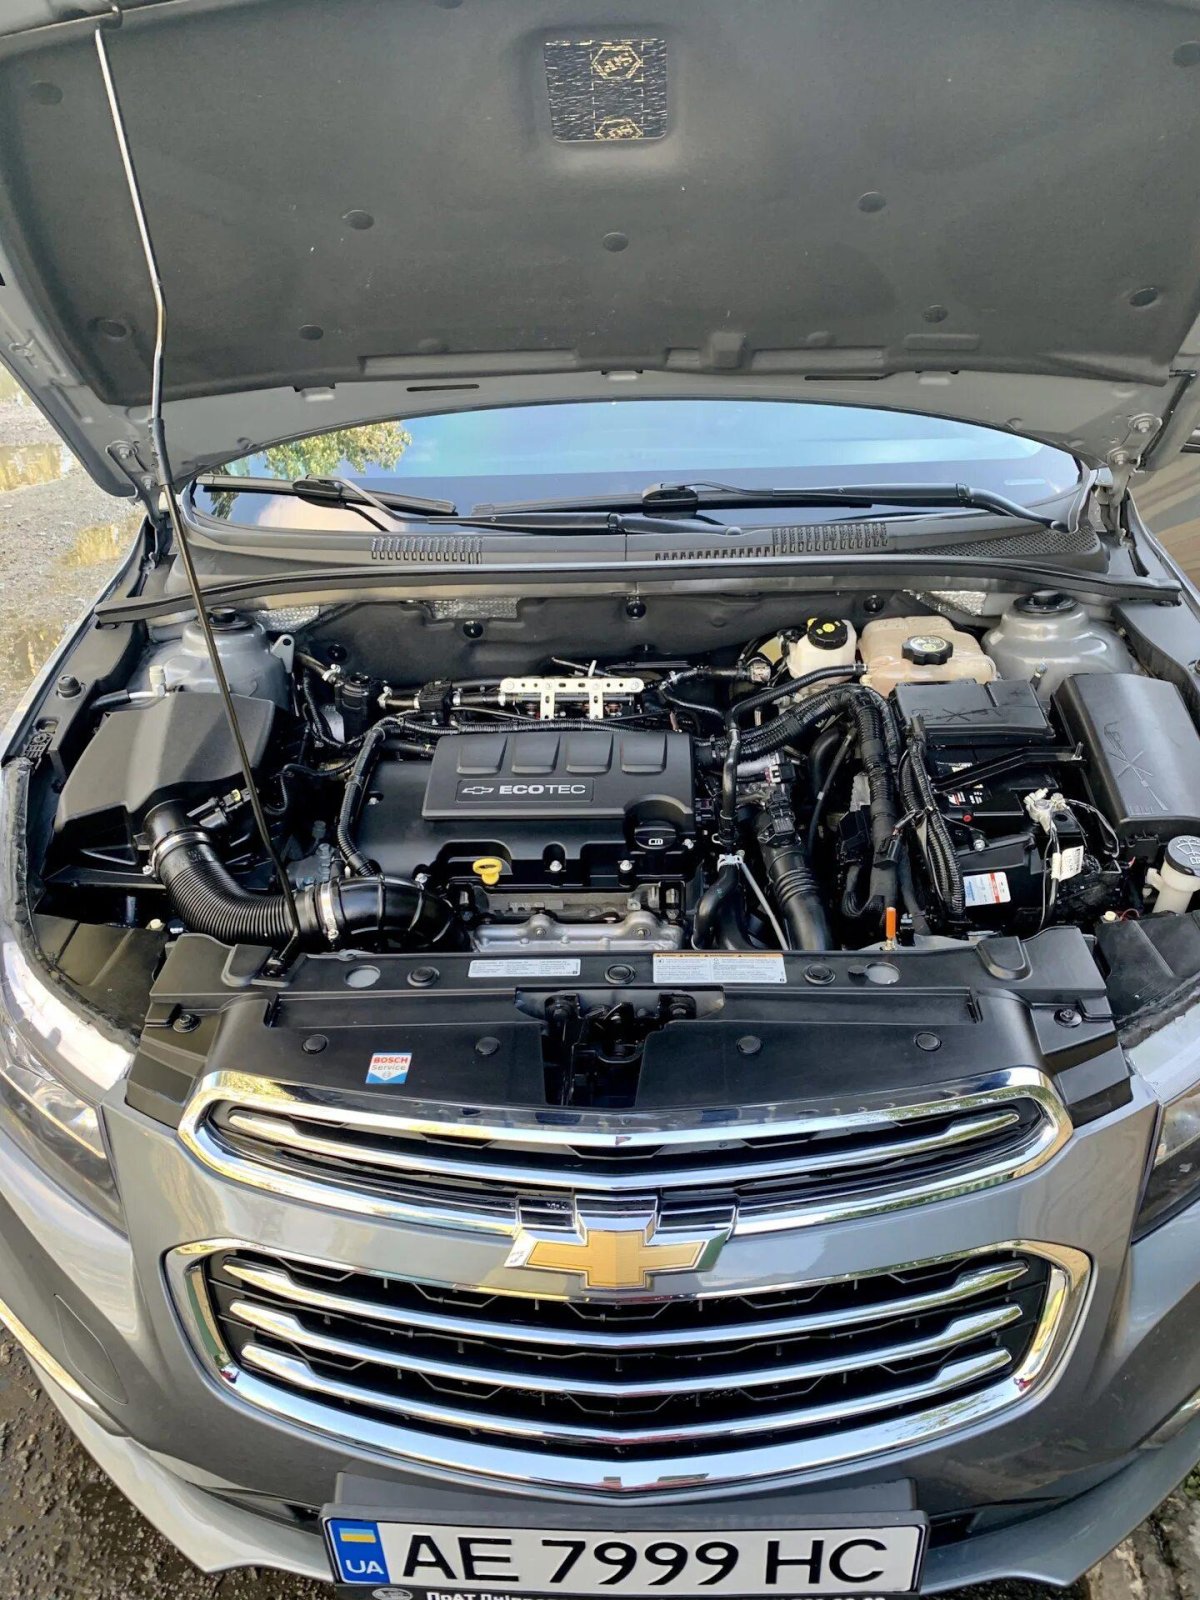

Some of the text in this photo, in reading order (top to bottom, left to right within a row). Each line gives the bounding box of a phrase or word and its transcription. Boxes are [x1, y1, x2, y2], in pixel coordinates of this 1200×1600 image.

[499, 785, 586, 795] ECOTEC
[373, 1056, 408, 1064] BOSCH
[403, 1534, 888, 1586] AE 7999 HC
[345, 1559, 385, 1575] UA
